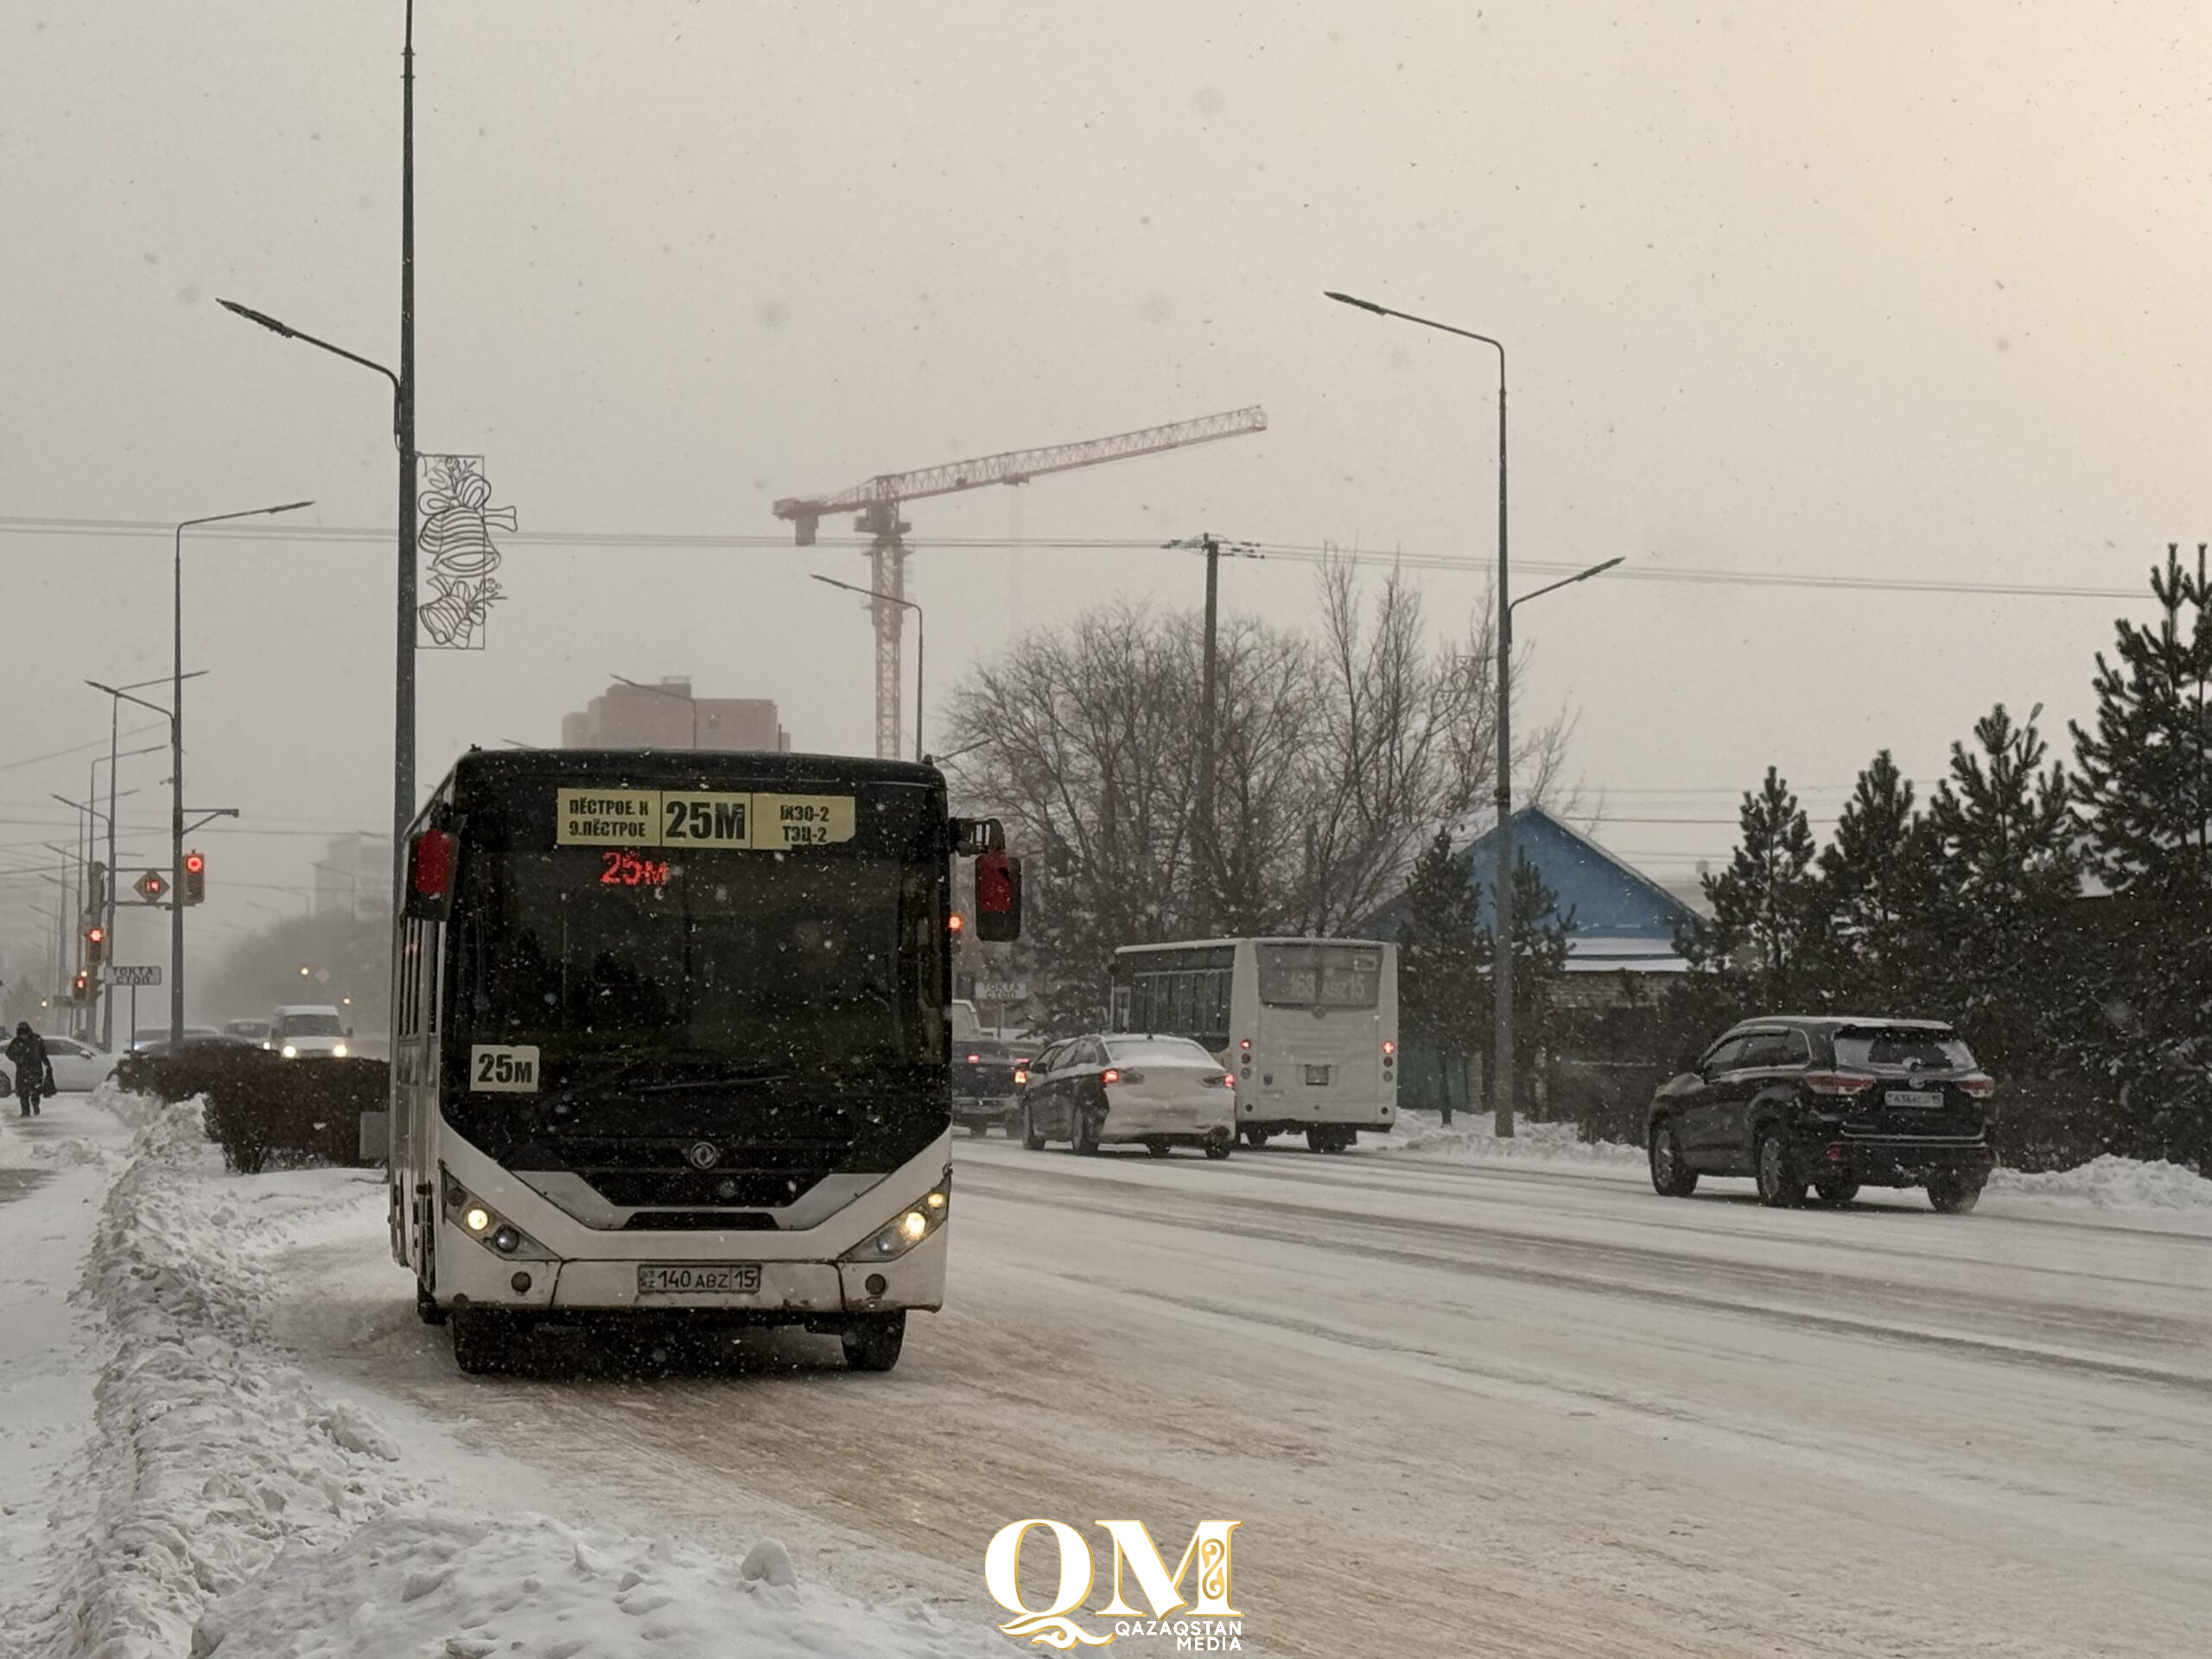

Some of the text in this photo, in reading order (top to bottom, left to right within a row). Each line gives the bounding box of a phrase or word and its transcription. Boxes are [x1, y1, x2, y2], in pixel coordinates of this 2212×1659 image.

[665, 800, 745, 839] 25М
[782, 825, 827, 844] ТЭЦ-2
[658, 1270, 757, 1288] 140 ABZ 15
